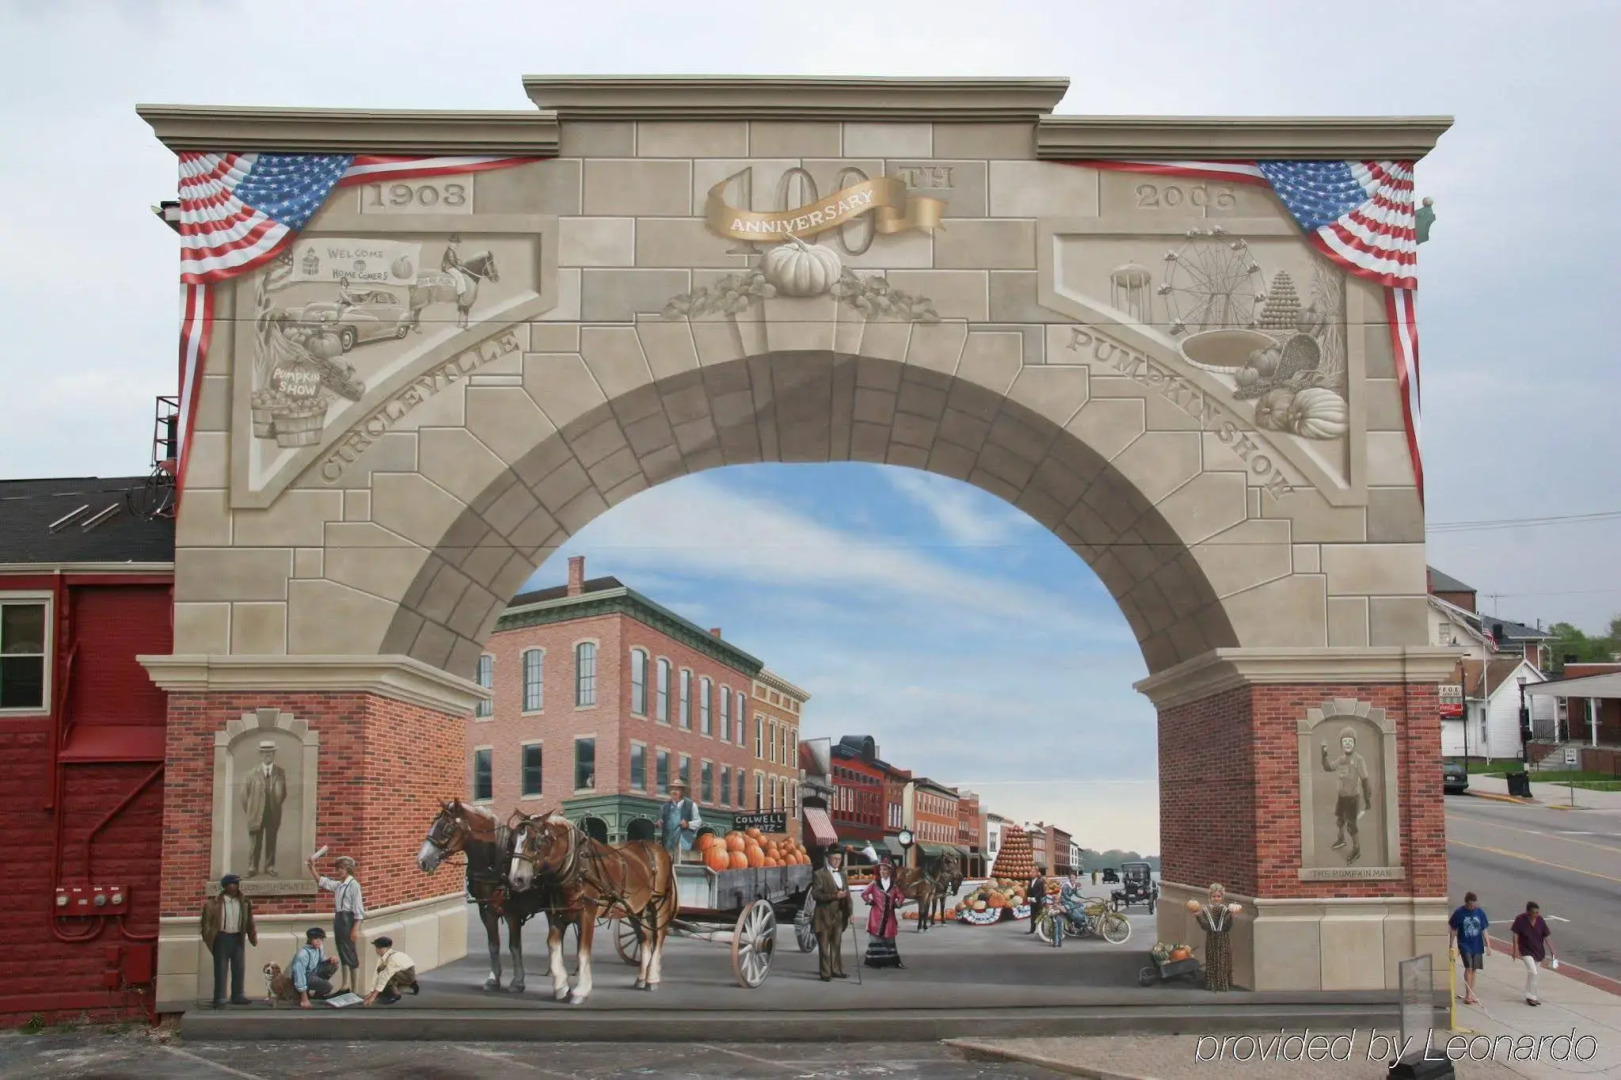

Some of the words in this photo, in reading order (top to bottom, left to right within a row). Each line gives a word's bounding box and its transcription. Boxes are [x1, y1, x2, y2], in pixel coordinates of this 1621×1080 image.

[898, 165, 955, 189] TH
[370, 183, 466, 207] 1903
[730, 189, 873, 233] ANNIVERSARY
[327, 248, 384, 259] WELCOME
[272, 367, 321, 389] PUMPKIN
[278, 381, 317, 396] SHOW
[321, 330, 520, 485] CIRCLEVILLE
[1065, 326, 1221, 430] PUMPKIN
[1213, 420, 1296, 502] SHOW
[735, 815, 784, 824] COLWELL
